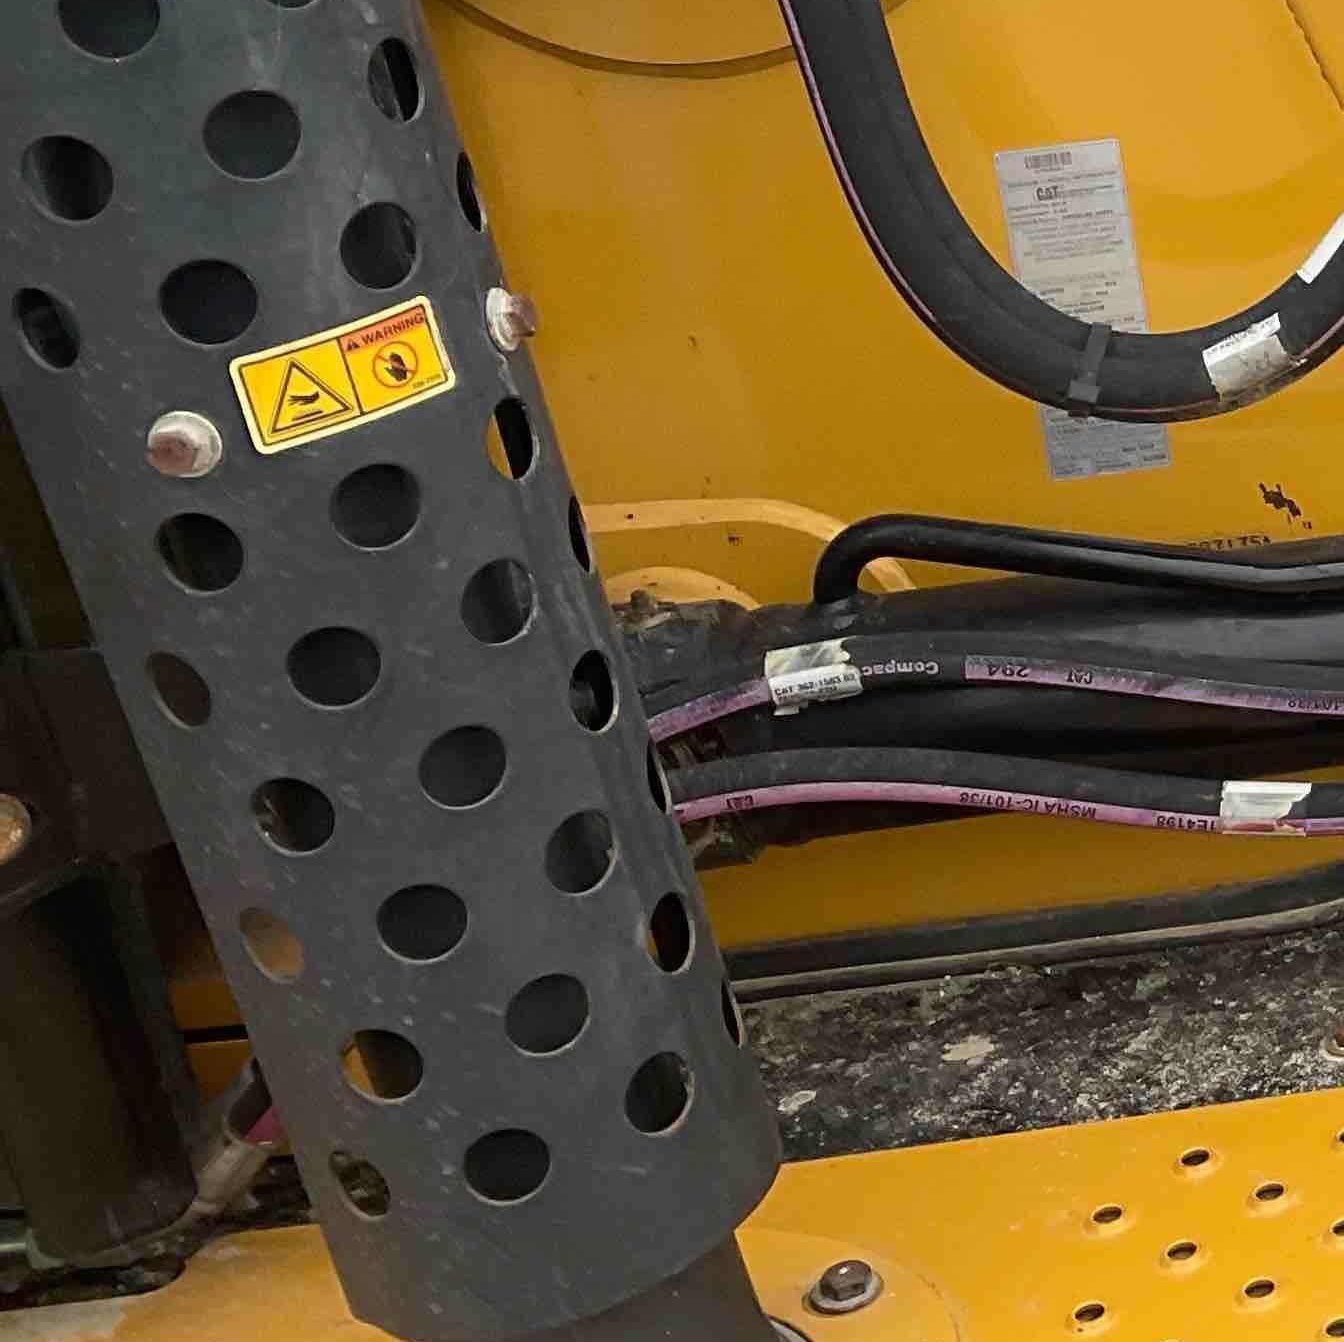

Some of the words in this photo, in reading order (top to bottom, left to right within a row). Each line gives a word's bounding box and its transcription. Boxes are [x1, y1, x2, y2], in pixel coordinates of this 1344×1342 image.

[362, 312, 424, 345] WARNING
[861, 659, 939, 676] Compac
[1066, 670, 1092, 684] CAT
[1043, 801, 1097, 818] MSHA
